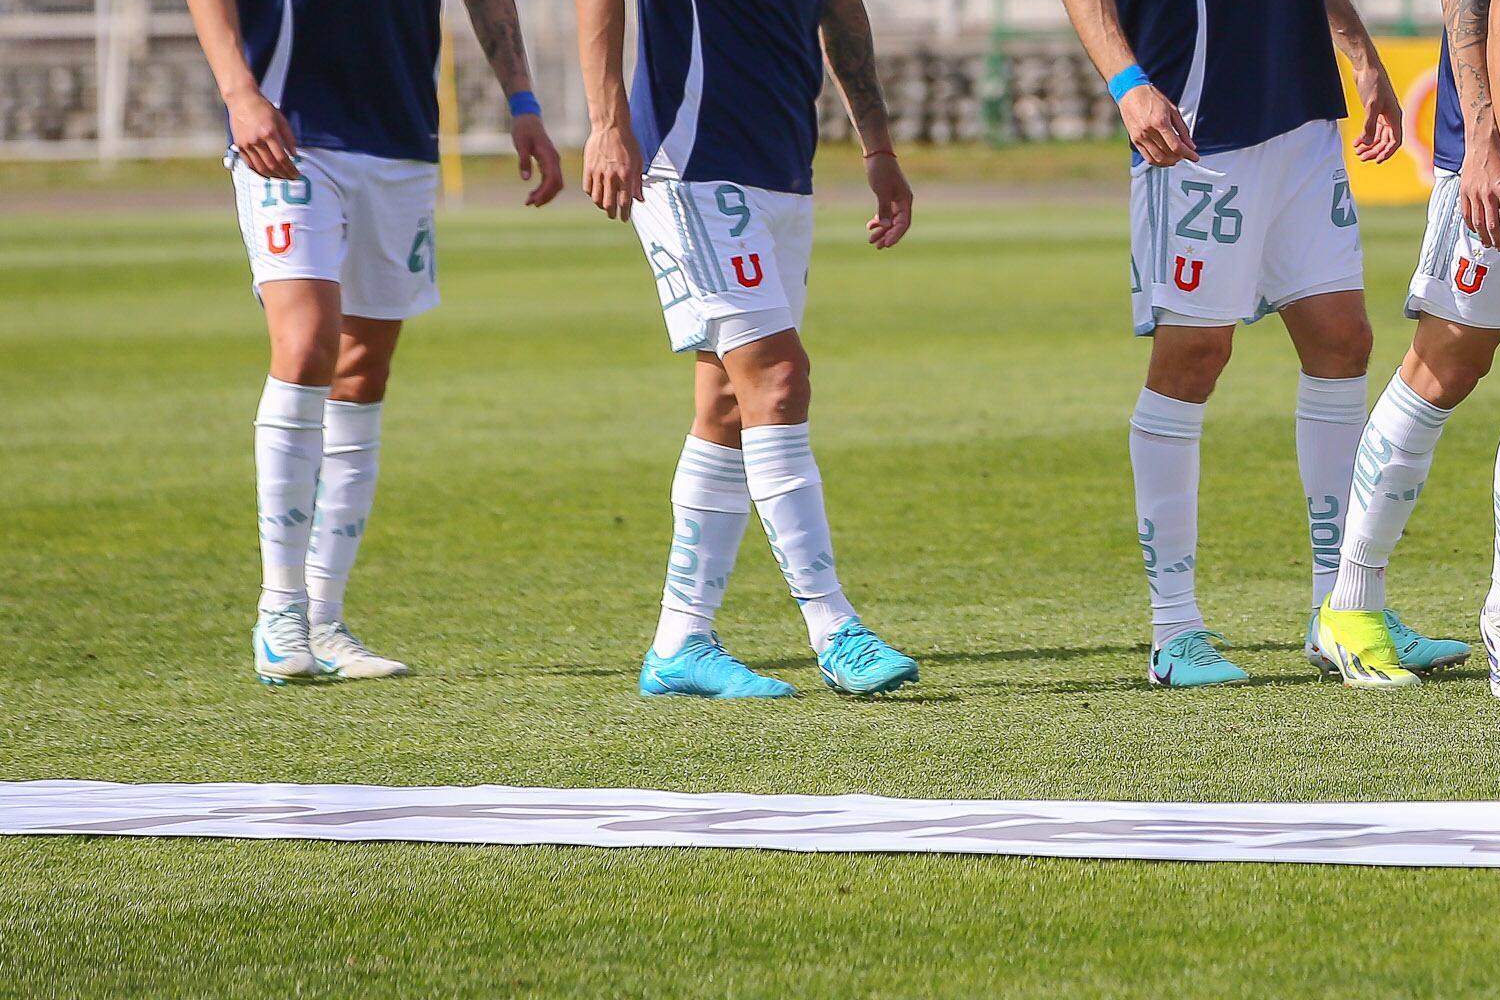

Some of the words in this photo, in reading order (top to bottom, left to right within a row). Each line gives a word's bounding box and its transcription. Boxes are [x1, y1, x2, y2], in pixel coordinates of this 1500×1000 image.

[715, 184, 750, 237] 9
[1175, 180, 1243, 243] 26
[266, 223, 292, 254] U
[731, 253, 763, 288] U
[1174, 255, 1203, 293] U
[1454, 256, 1489, 296] U
